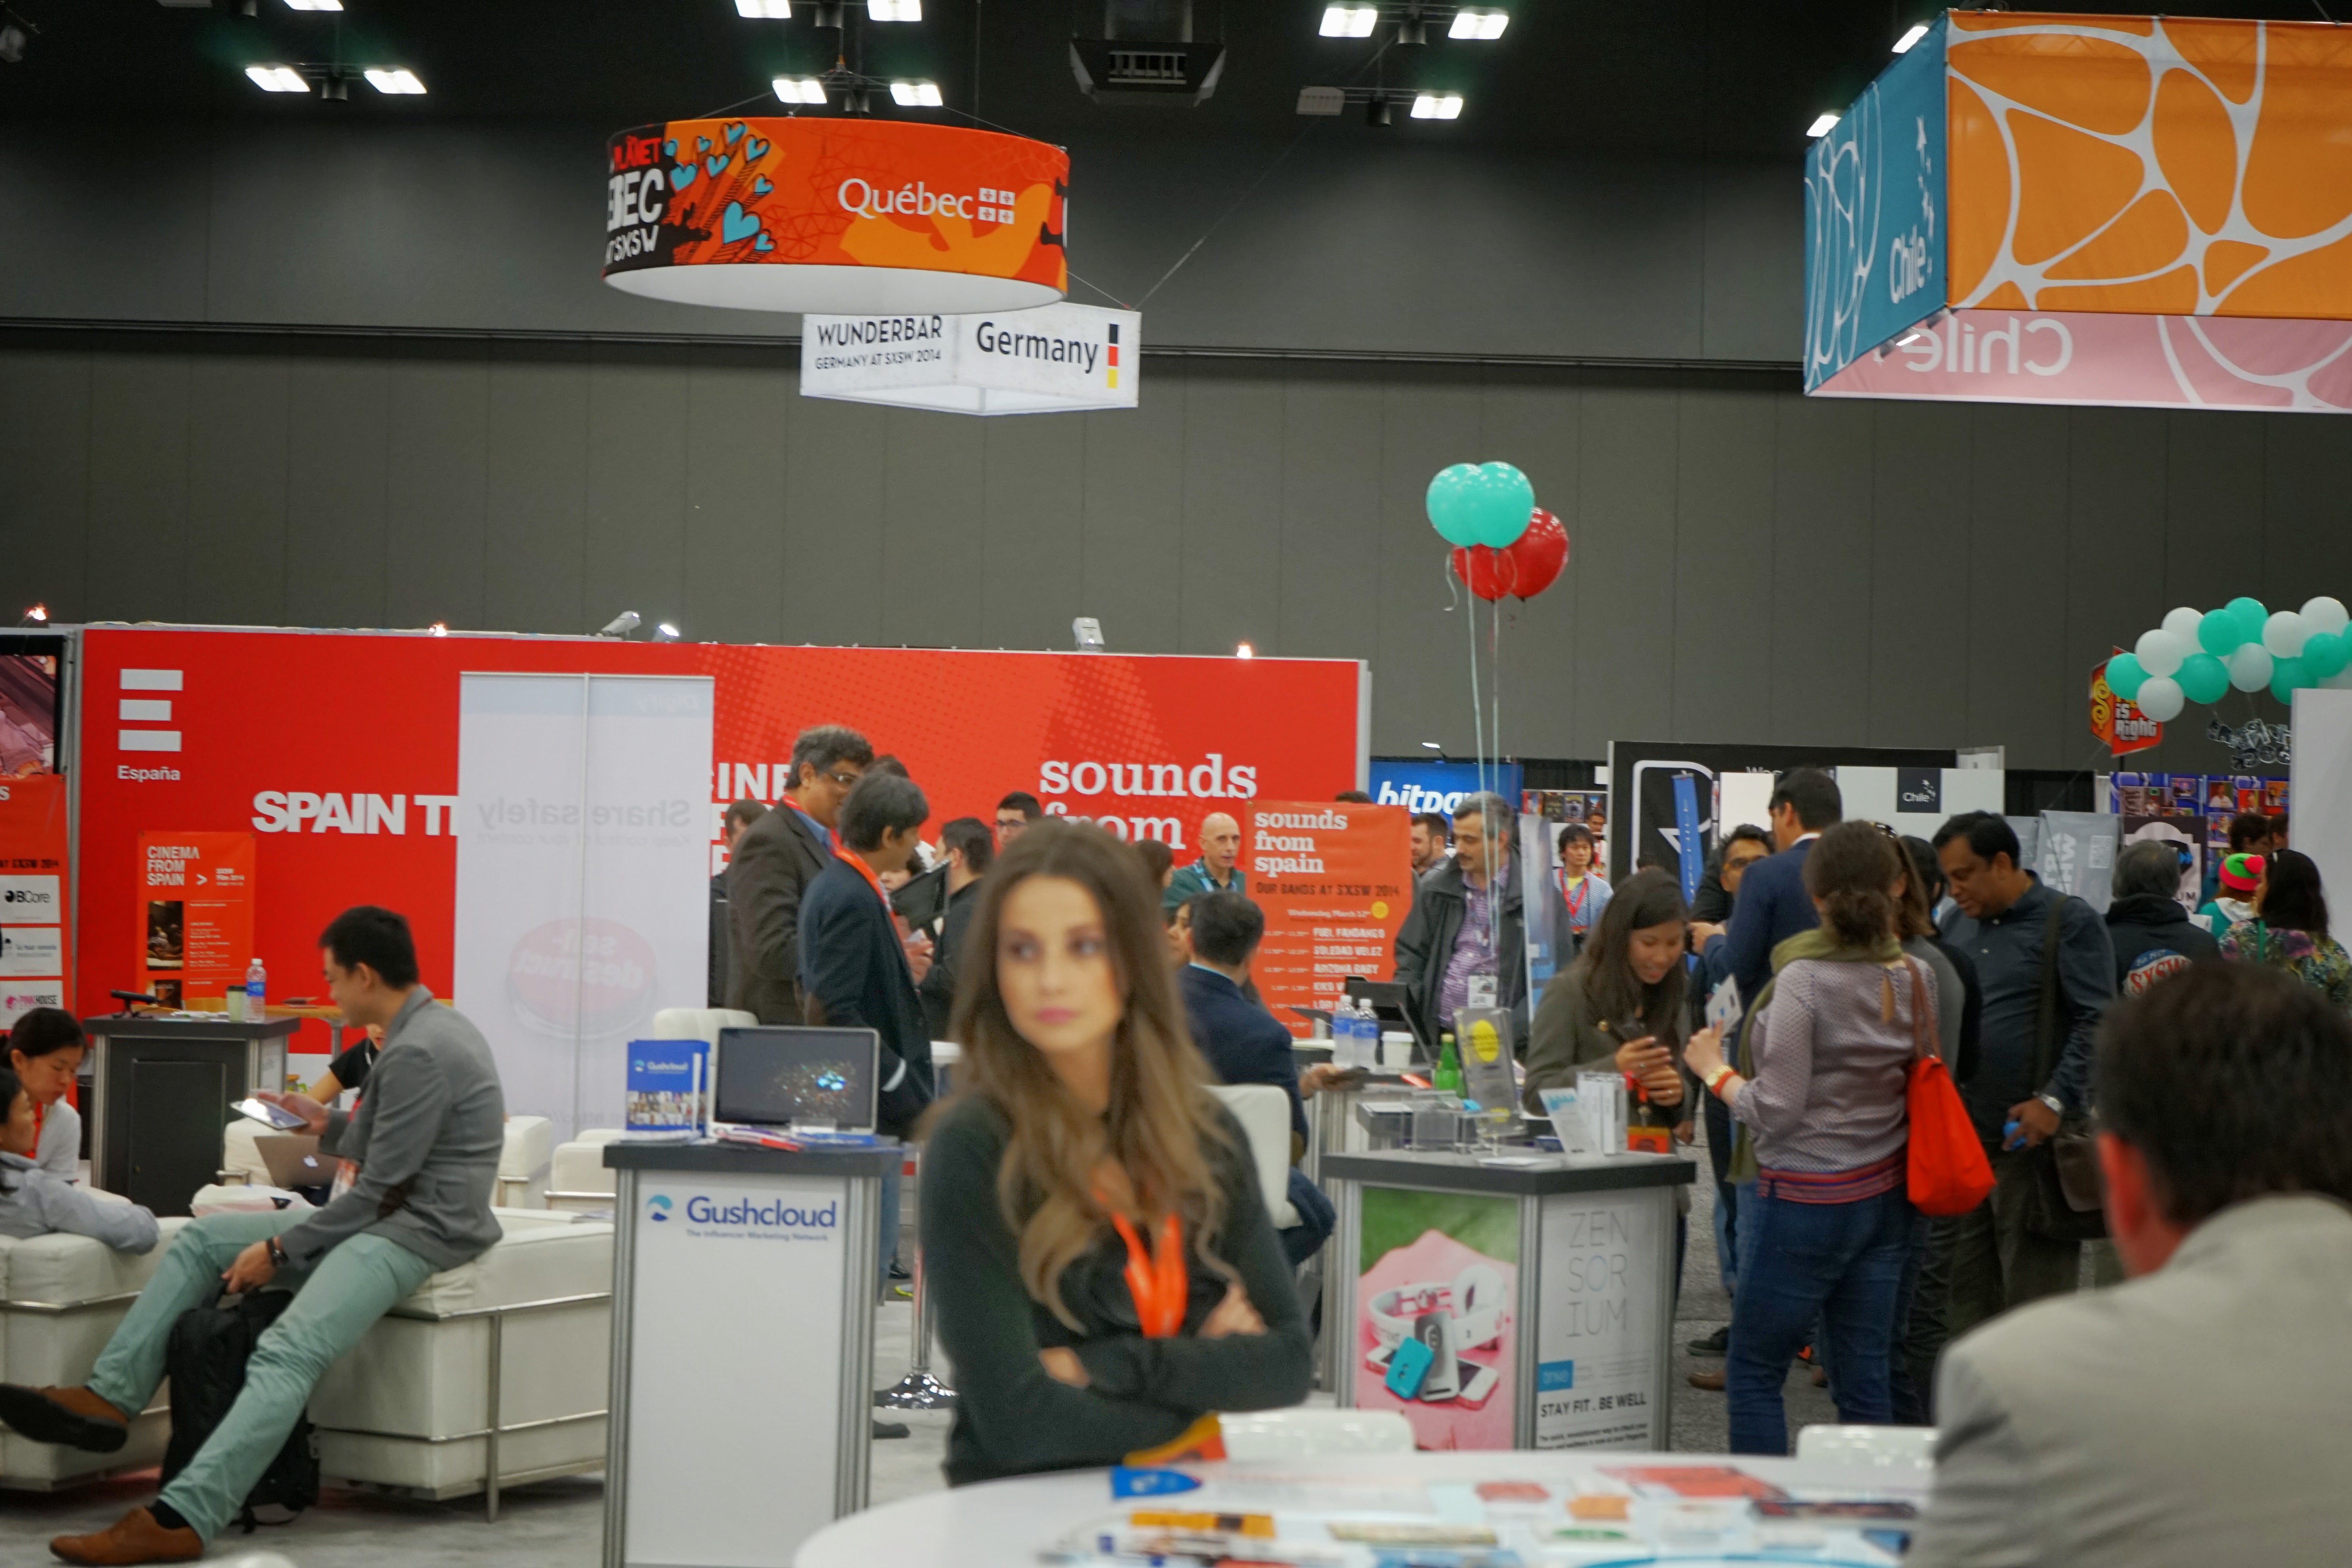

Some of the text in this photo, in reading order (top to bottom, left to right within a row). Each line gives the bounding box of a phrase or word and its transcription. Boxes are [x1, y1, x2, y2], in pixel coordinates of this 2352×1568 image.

[838, 178, 974, 219] Québec
[1889, 224, 1926, 305] Chile
[817, 315, 942, 347] WUNDERBAR
[815, 348, 941, 369] GERMANY AT SXSW 2014
[976, 321, 1099, 374] Germany
[2115, 717, 2158, 740] Right
[117, 765, 181, 783] España
[1040, 753, 1257, 799] sounds
[1902, 792, 1930, 802] Chile
[252, 791, 406, 835] SPAIN
[1254, 809, 1348, 830] sounds
[147, 846, 200, 859] CINEMA
[1254, 830, 1316, 852] from
[147, 859, 186, 873] FROM
[1254, 853, 1325, 878] spain
[147, 873, 185, 886] SPAIN
[1319, 884, 1332, 895] AT
[1337, 884, 1371, 897] SXSW
[1375, 884, 1399, 897] 2014
[16, 890, 51, 903] BCore
[686, 1196, 836, 1228] Gushcloud
[1568, 1210, 1628, 1248] ZEN
[1568, 1254, 1627, 1293] SOR
[1567, 1299, 1626, 1337] IUM
[1541, 1402, 1570, 1417] STAY
[1573, 1398, 1590, 1413] FIT
[1599, 1395, 1613, 1410] BE
[1615, 1392, 1647, 1408] WELL
